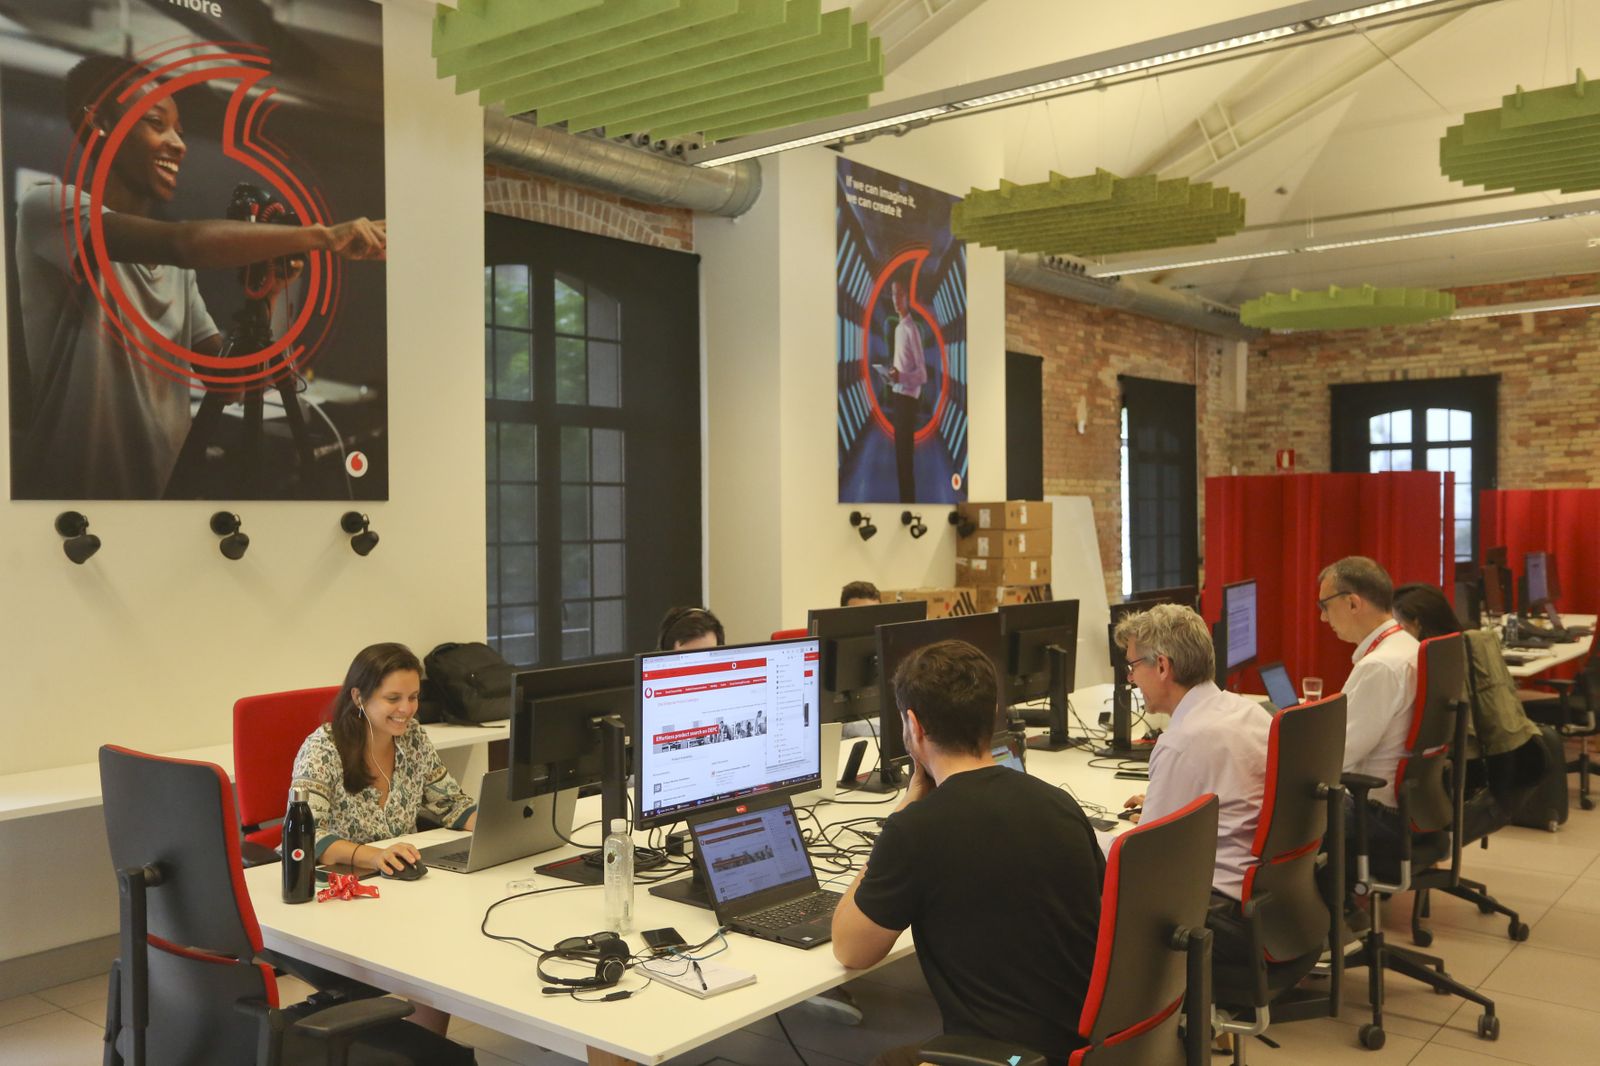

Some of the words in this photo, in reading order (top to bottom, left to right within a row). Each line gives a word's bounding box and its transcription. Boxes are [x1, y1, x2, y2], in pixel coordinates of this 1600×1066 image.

[845, 175, 853, 188] If
[853, 180, 865, 192] we
[865, 184, 879, 196] can
[879, 186, 908, 205] imagine
[846, 193, 858, 205] we
[858, 197, 872, 209] can
[872, 201, 896, 217] create
[896, 206, 903, 218] it
